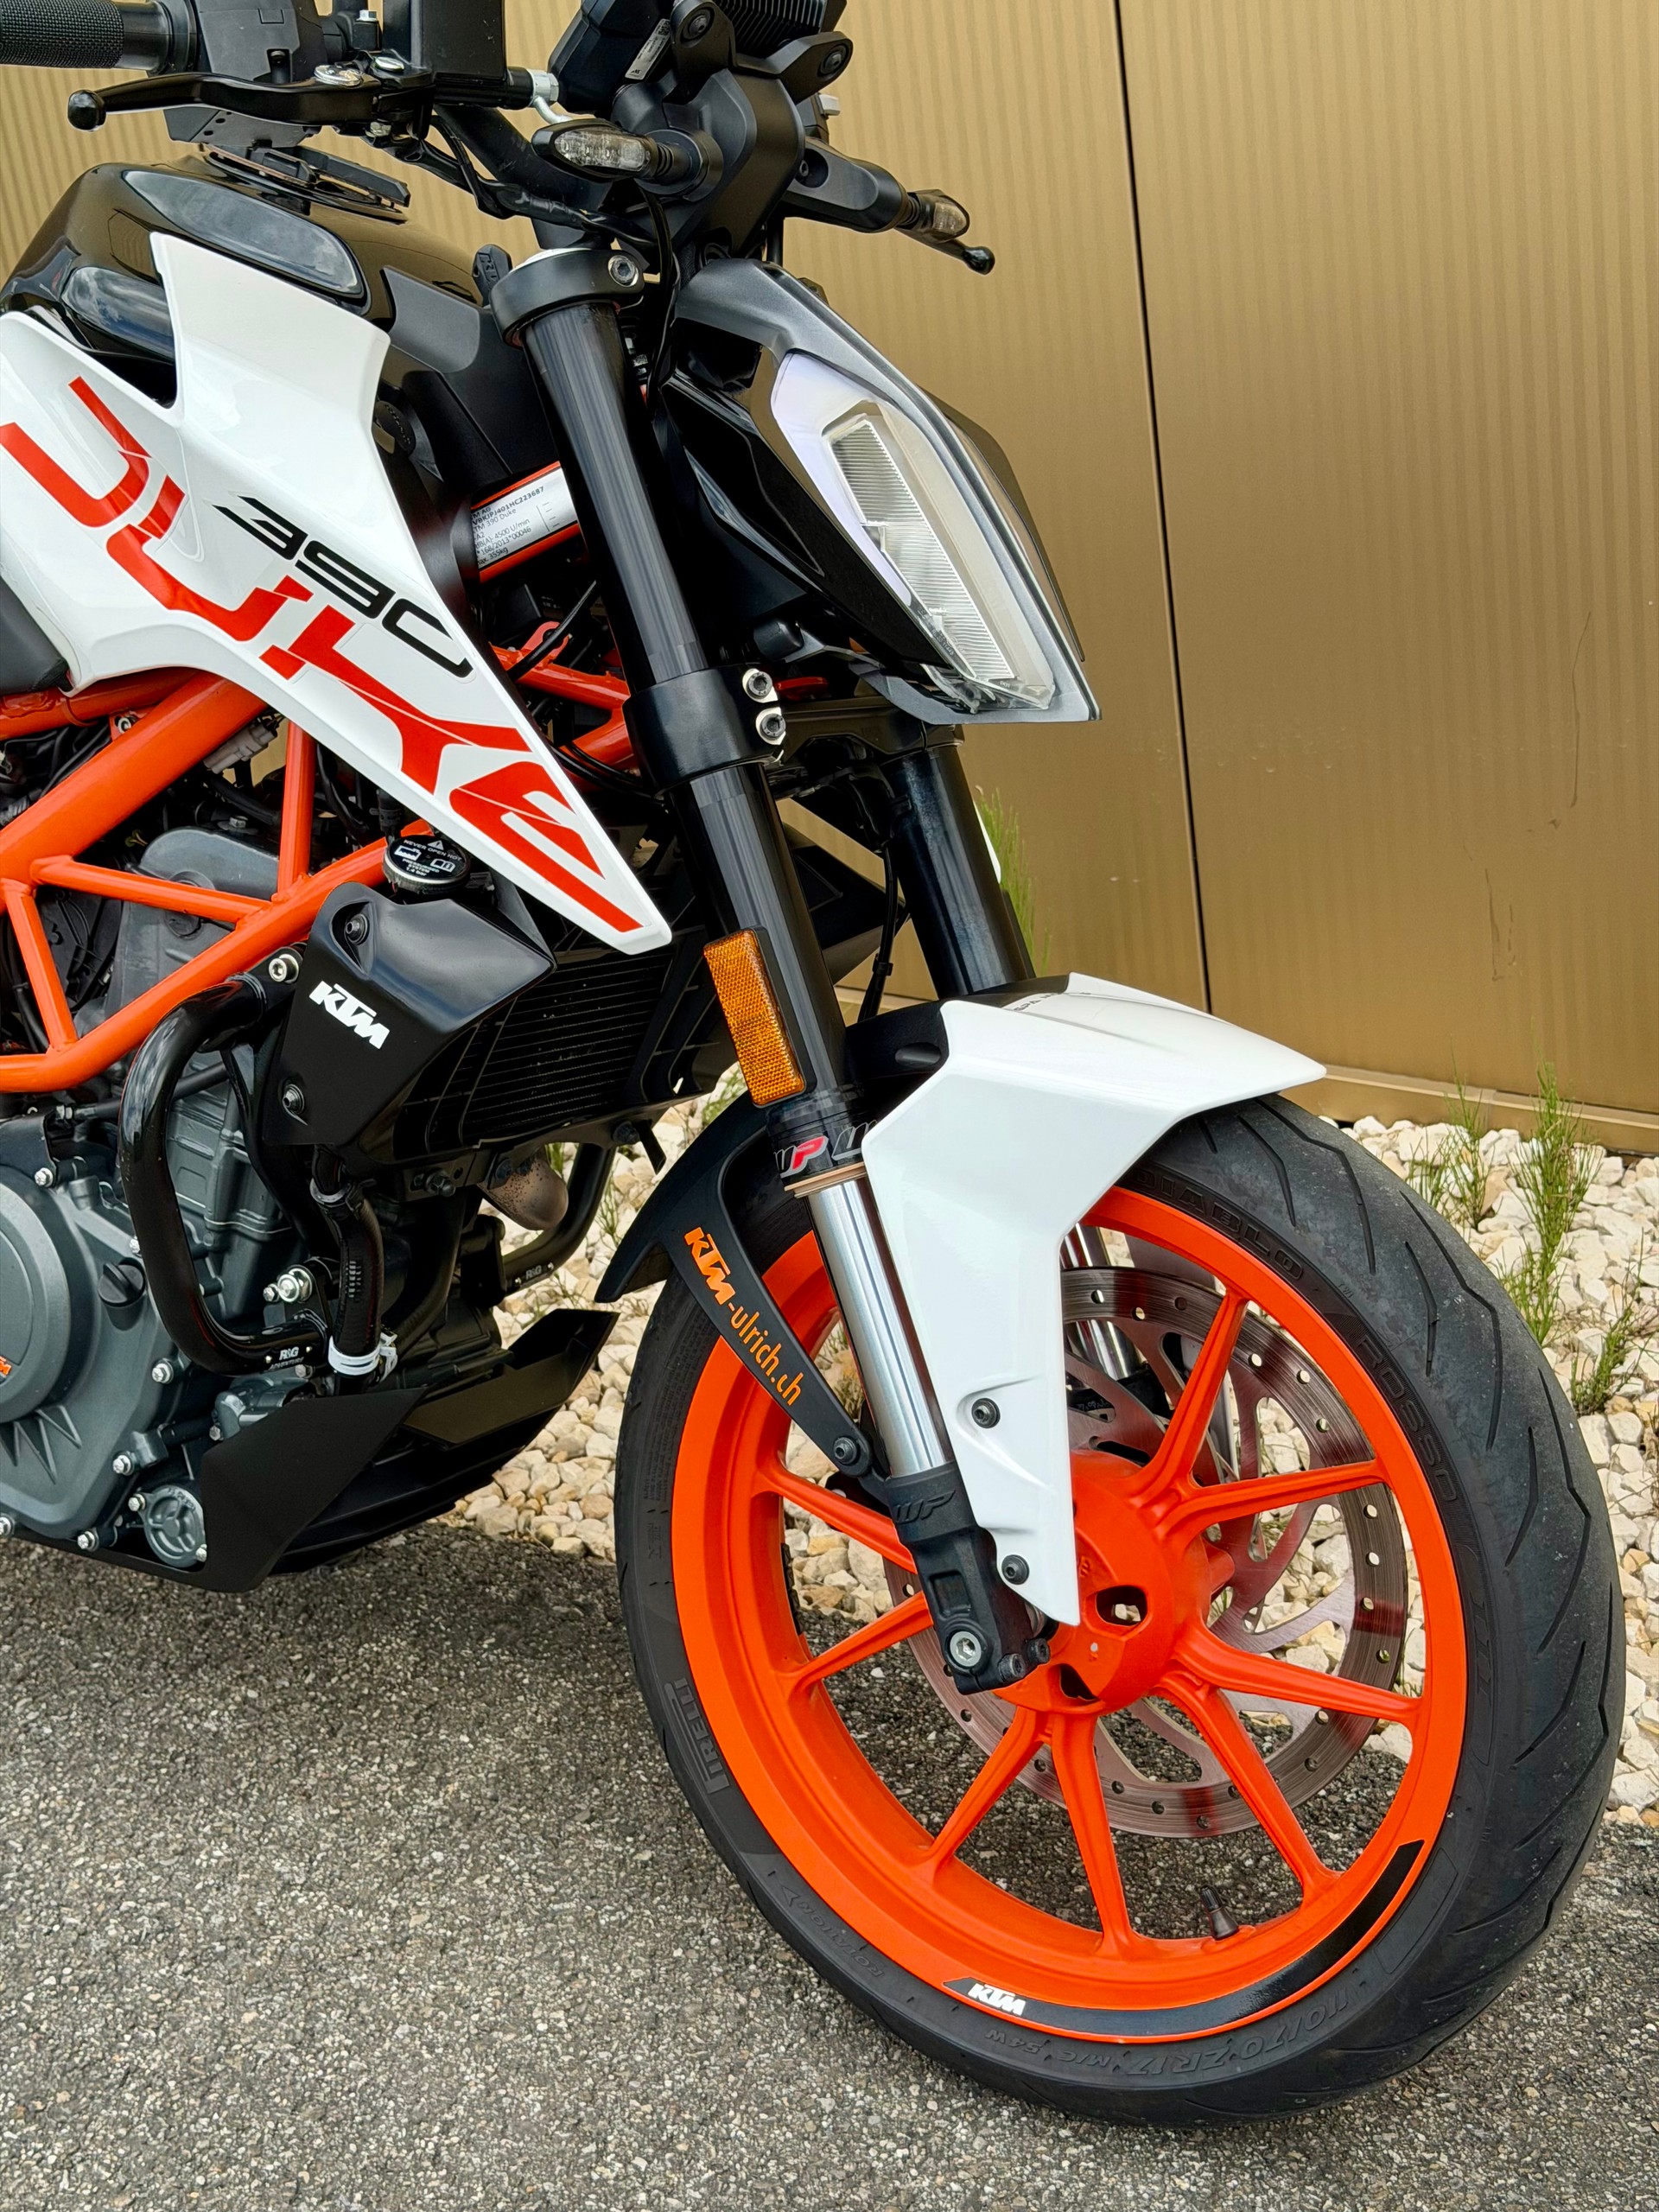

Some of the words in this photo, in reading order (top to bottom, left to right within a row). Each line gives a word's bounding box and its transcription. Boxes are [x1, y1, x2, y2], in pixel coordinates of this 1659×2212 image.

[486, 518, 499, 528] 390
[500, 508, 517, 521] Duke
[494, 528, 511, 539] 4500
[510, 518, 531, 532] U/min
[212, 495, 474, 678] 390
[404, 839, 427, 850] NEVER
[427, 847, 447, 856] OPEN
[447, 853, 463, 861] HOT
[308, 980, 391, 1050] KTM
[683, 1226, 804, 1407] KTM-ulrich.ch
[1134, 1167, 1304, 1281] DIABLO
[1356, 1334, 1458, 1503] ROSSO
[895, 1488, 957, 1525] WP
[664, 1677, 730, 1795] PIRELLI
[796, 1900, 886, 1978] ROTATION
[967, 1982, 1027, 2016] KTM
